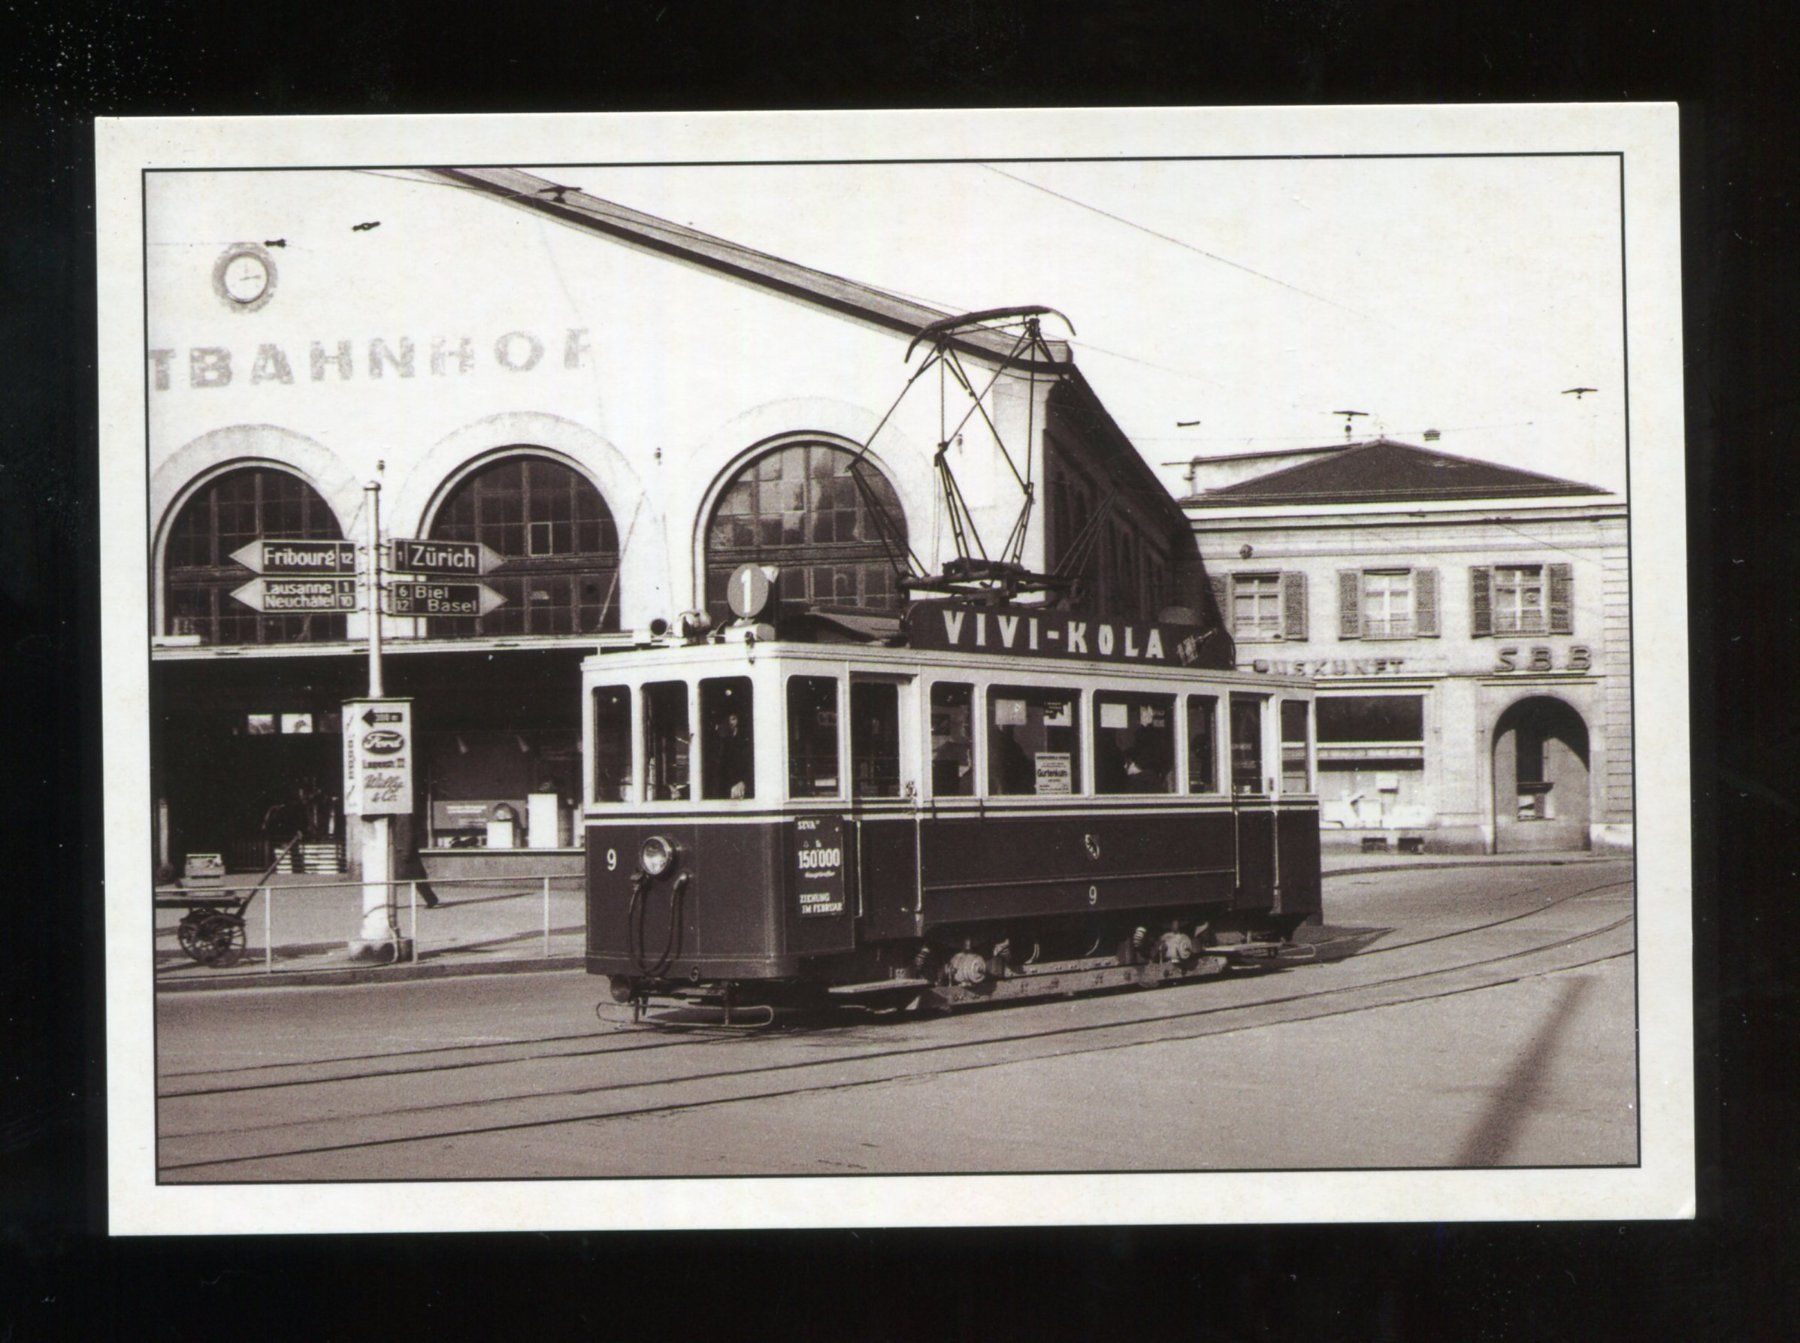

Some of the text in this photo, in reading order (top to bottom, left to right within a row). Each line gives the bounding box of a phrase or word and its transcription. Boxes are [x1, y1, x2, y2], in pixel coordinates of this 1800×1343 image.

[263, 547, 354, 567] Fribourg 12
[411, 545, 475, 568] Zürich
[343, 582, 350, 592] 1
[399, 586, 449, 599] 6 Biel
[741, 569, 752, 613] 1
[341, 596, 353, 607] 10
[396, 600, 477, 612] 12 Basel
[942, 610, 1165, 659] VIVI-KOLA
[363, 733, 404, 749] Ford
[607, 848, 617, 871] 9
[1088, 885, 1097, 905] 9
